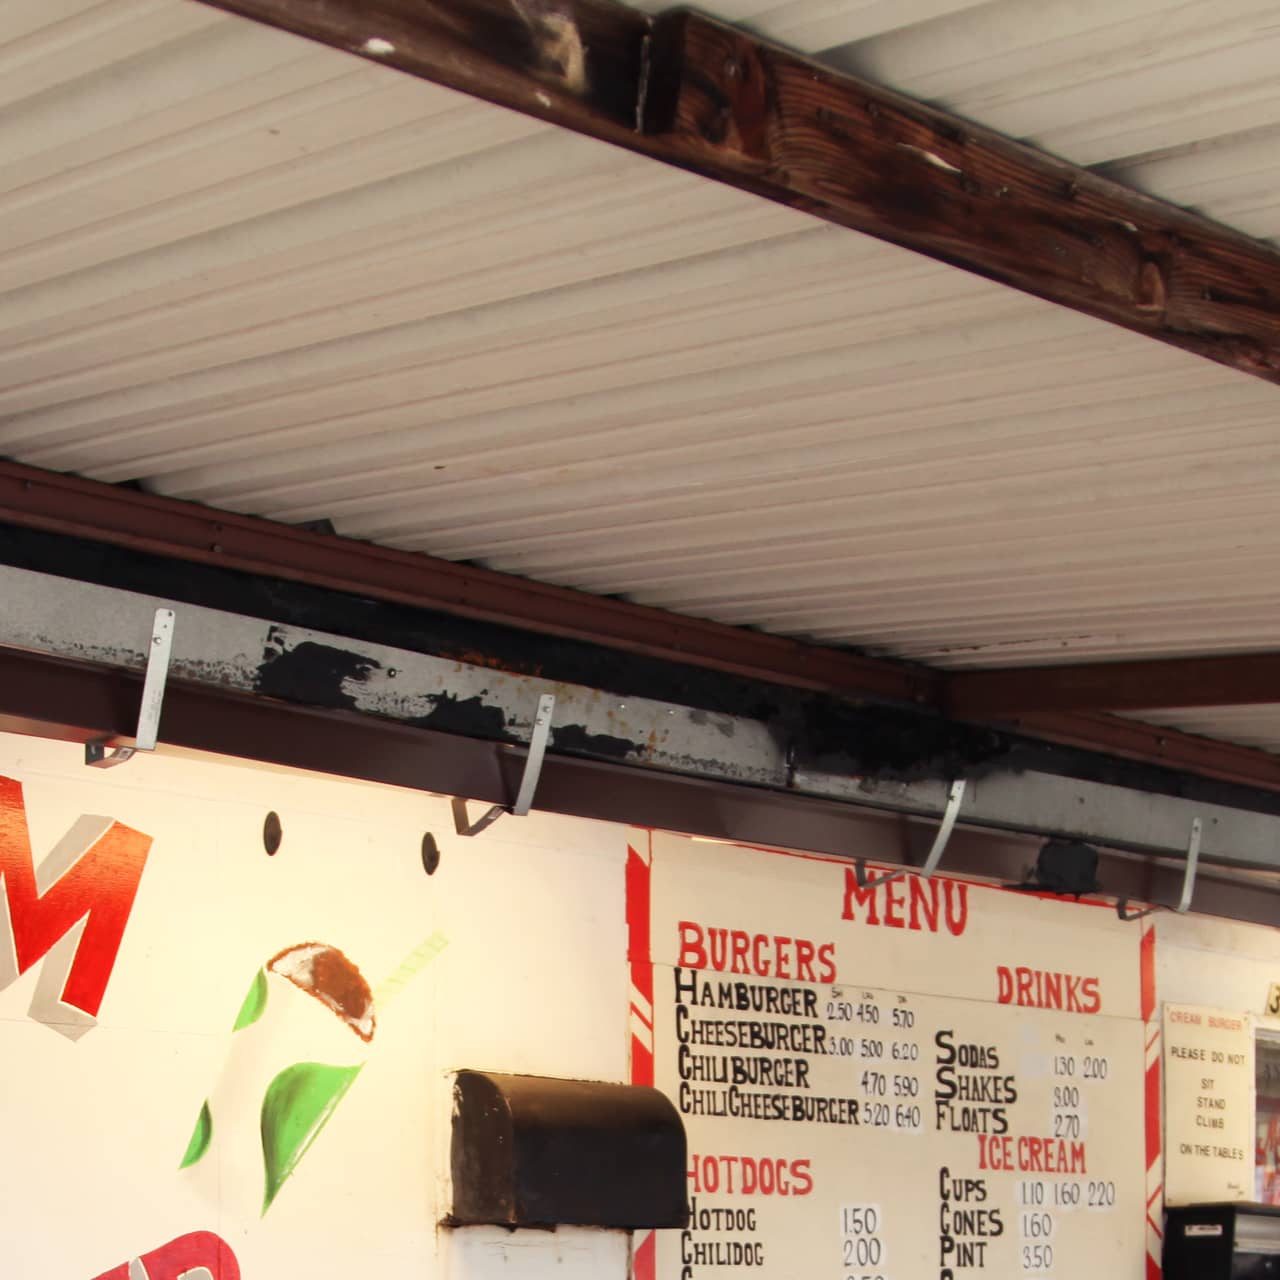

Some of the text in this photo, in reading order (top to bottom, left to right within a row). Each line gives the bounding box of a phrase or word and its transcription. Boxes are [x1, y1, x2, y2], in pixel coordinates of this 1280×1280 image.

[841, 867, 968, 936] MENU
[677, 921, 836, 983] BURGERS
[674, 966, 818, 1018] HAMBURGER
[826, 1002, 852, 1021] 2.50
[996, 966, 1102, 1014] DRINKS
[675, 1004, 828, 1055] CHEESEBURGER
[892, 1042, 919, 1061] 6.20
[1170, 1011, 1202, 1025] CREAM
[934, 1030, 1000, 1069] SODAS
[1171, 1046, 1246, 1065] PLEASE DO NOT
[934, 1065, 1018, 1104] SHAKES
[1201, 1078, 1215, 1090] SIT
[935, 1100, 1009, 1135] FLOATS
[1196, 1095, 1226, 1109] STAND
[1195, 1115, 1224, 1129] CLIMB
[976, 1134, 1087, 1175] ICE CREAM
[1180, 1143, 1245, 1161] ON THE TABLES
[939, 1166, 987, 1202] CUPS
[843, 1207, 877, 1235] 1.50
[939, 1202, 1004, 1237] CONES
[680, 1230, 764, 1266] CHILIDOG
[939, 1235, 1053, 1270] PINT 3.50
